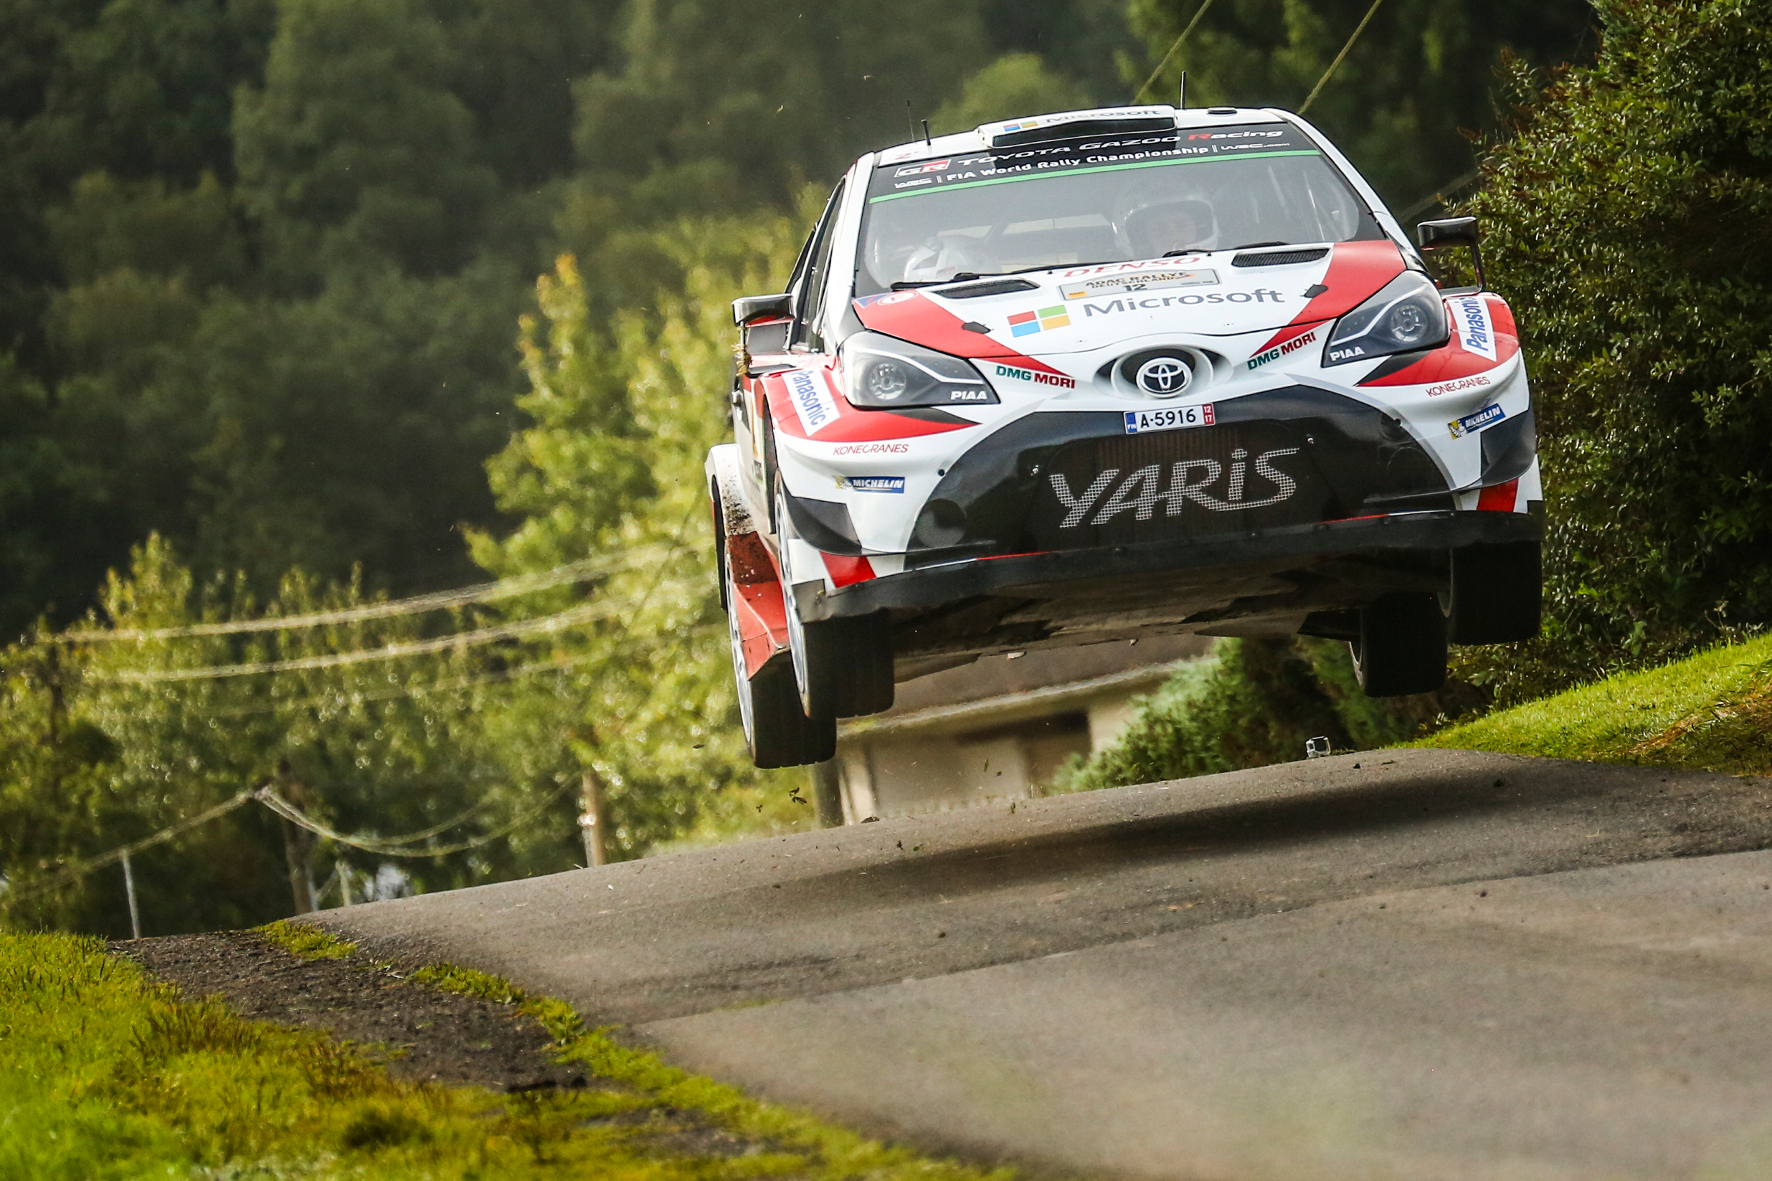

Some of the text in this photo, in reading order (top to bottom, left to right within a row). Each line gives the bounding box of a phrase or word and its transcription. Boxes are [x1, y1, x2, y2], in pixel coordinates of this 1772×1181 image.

[957, 130, 1284, 166] TOYOTA GAZOO Racing
[947, 172, 977, 182] FIA
[980, 161, 1032, 176] World
[1037, 158, 1081, 169] Rally
[1086, 145, 1209, 163] Championship
[1063, 257, 1200, 277] DENSO
[1123, 284, 1149, 292] 12
[1083, 288, 1286, 317] Microsoft
[1246, 331, 1317, 371] DMG MORI
[1329, 346, 1365, 361] PIAA
[995, 365, 1076, 389] DMG MORI
[1425, 376, 1491, 398] KONECRANES
[790, 370, 830, 426] Panasonic
[950, 390, 988, 400] PIAA
[1140, 409, 1196, 428] A-5916
[1465, 406, 1501, 428] MICHELIN
[832, 443, 909, 456] KONECRANES
[852, 479, 905, 488] MICHELIN
